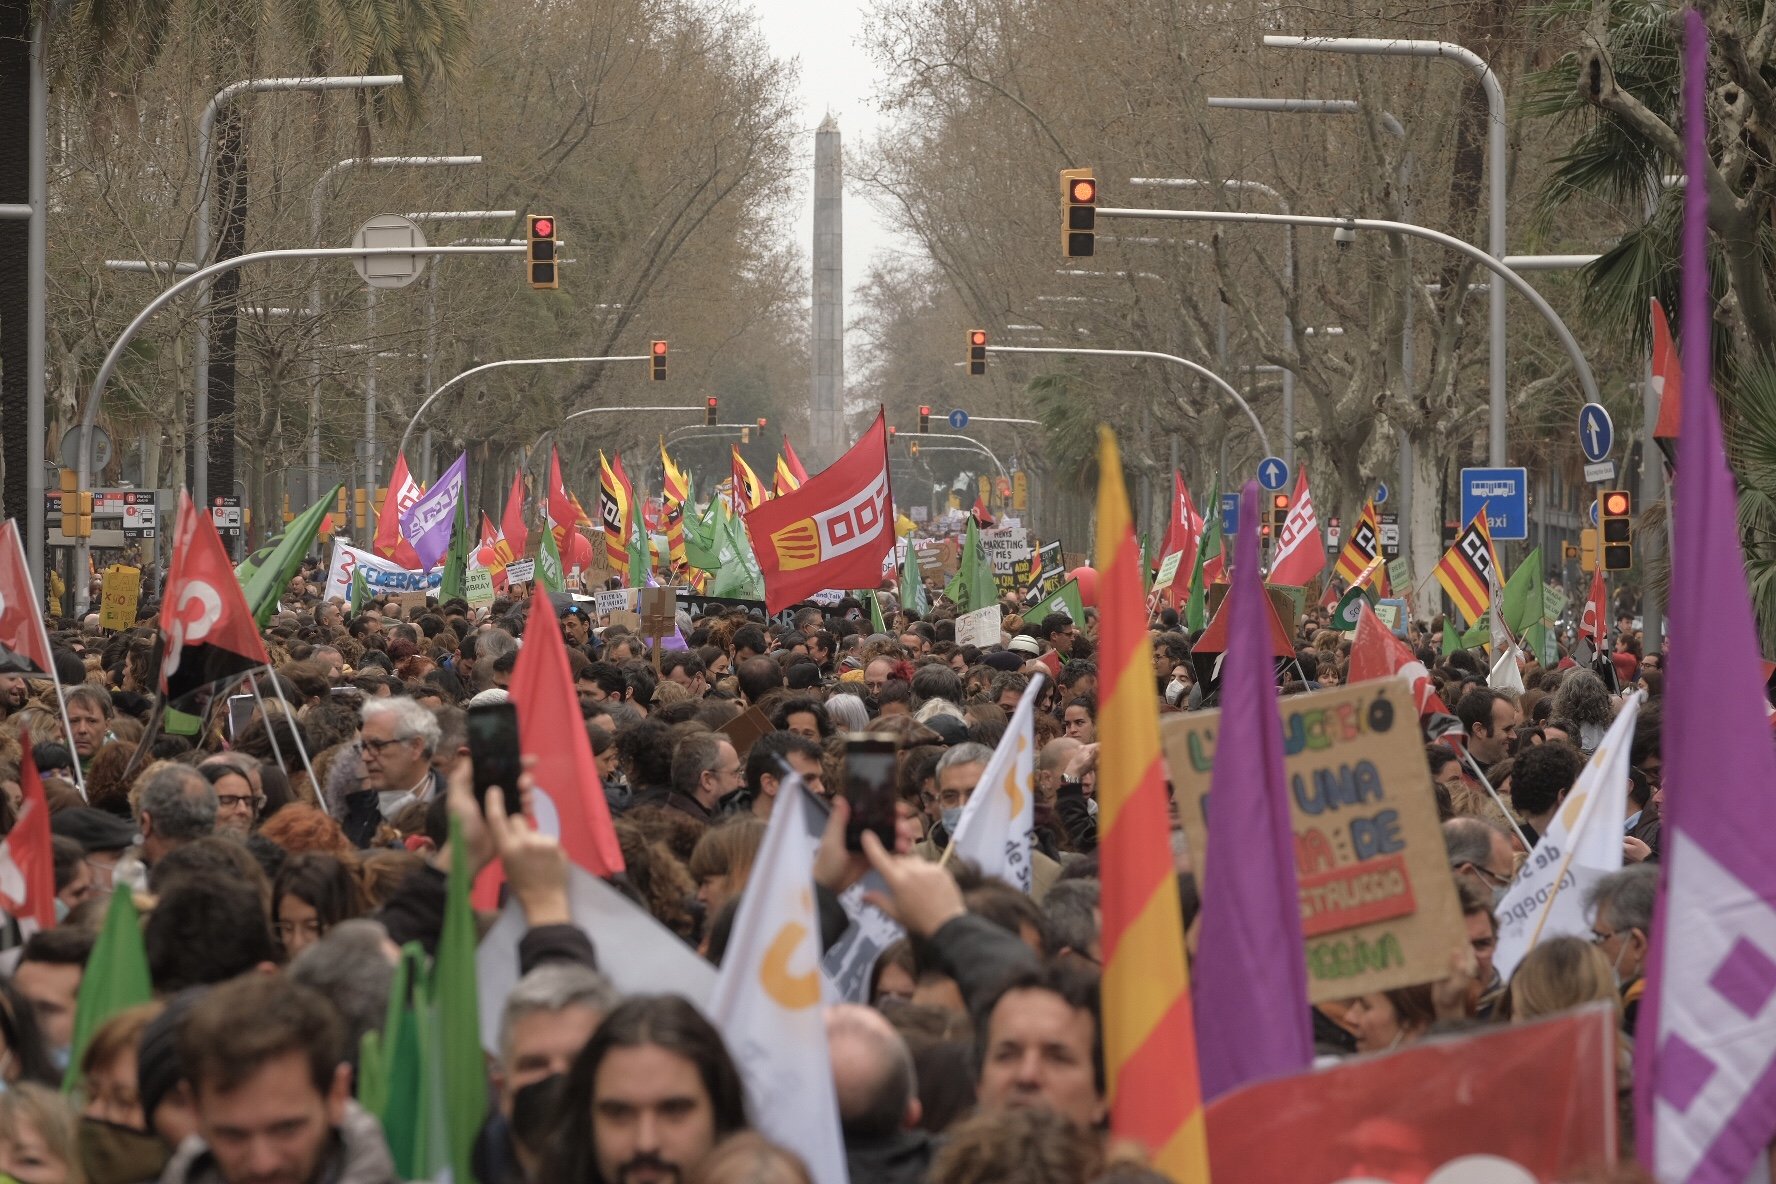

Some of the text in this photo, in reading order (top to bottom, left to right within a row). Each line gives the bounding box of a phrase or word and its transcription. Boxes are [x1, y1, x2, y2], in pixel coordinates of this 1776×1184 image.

[1487, 514, 1507, 528] axi
[470, 573, 487, 582] BYE
[1292, 759, 1384, 815] UNA
[1349, 809, 1408, 862] DE
